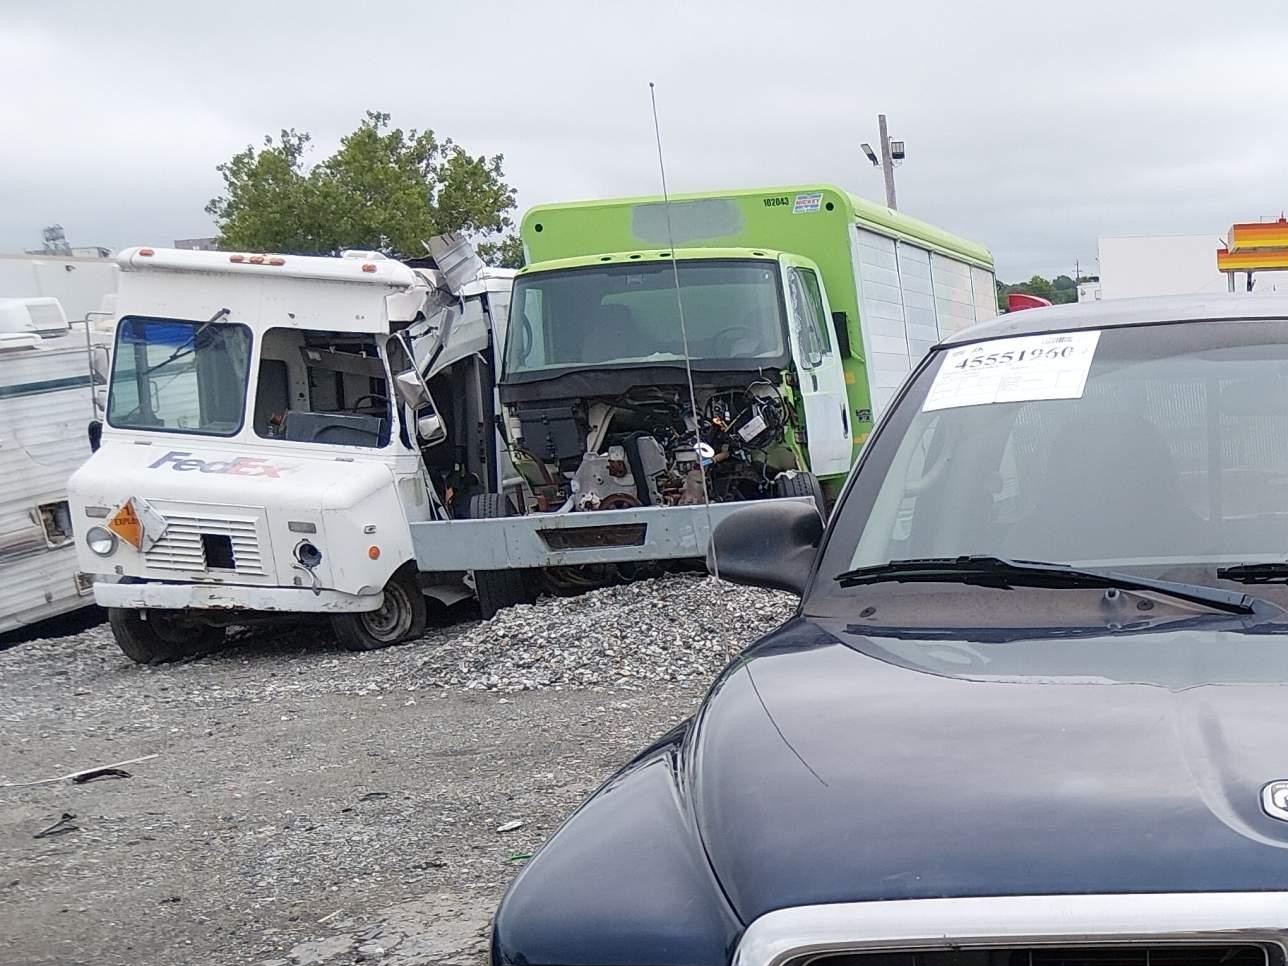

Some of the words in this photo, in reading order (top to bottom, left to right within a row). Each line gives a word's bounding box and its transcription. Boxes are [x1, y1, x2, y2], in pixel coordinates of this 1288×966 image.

[763, 197, 789, 207] 102043
[955, 346, 1074, 369] 45551960
[148, 451, 281, 478] FedEx
